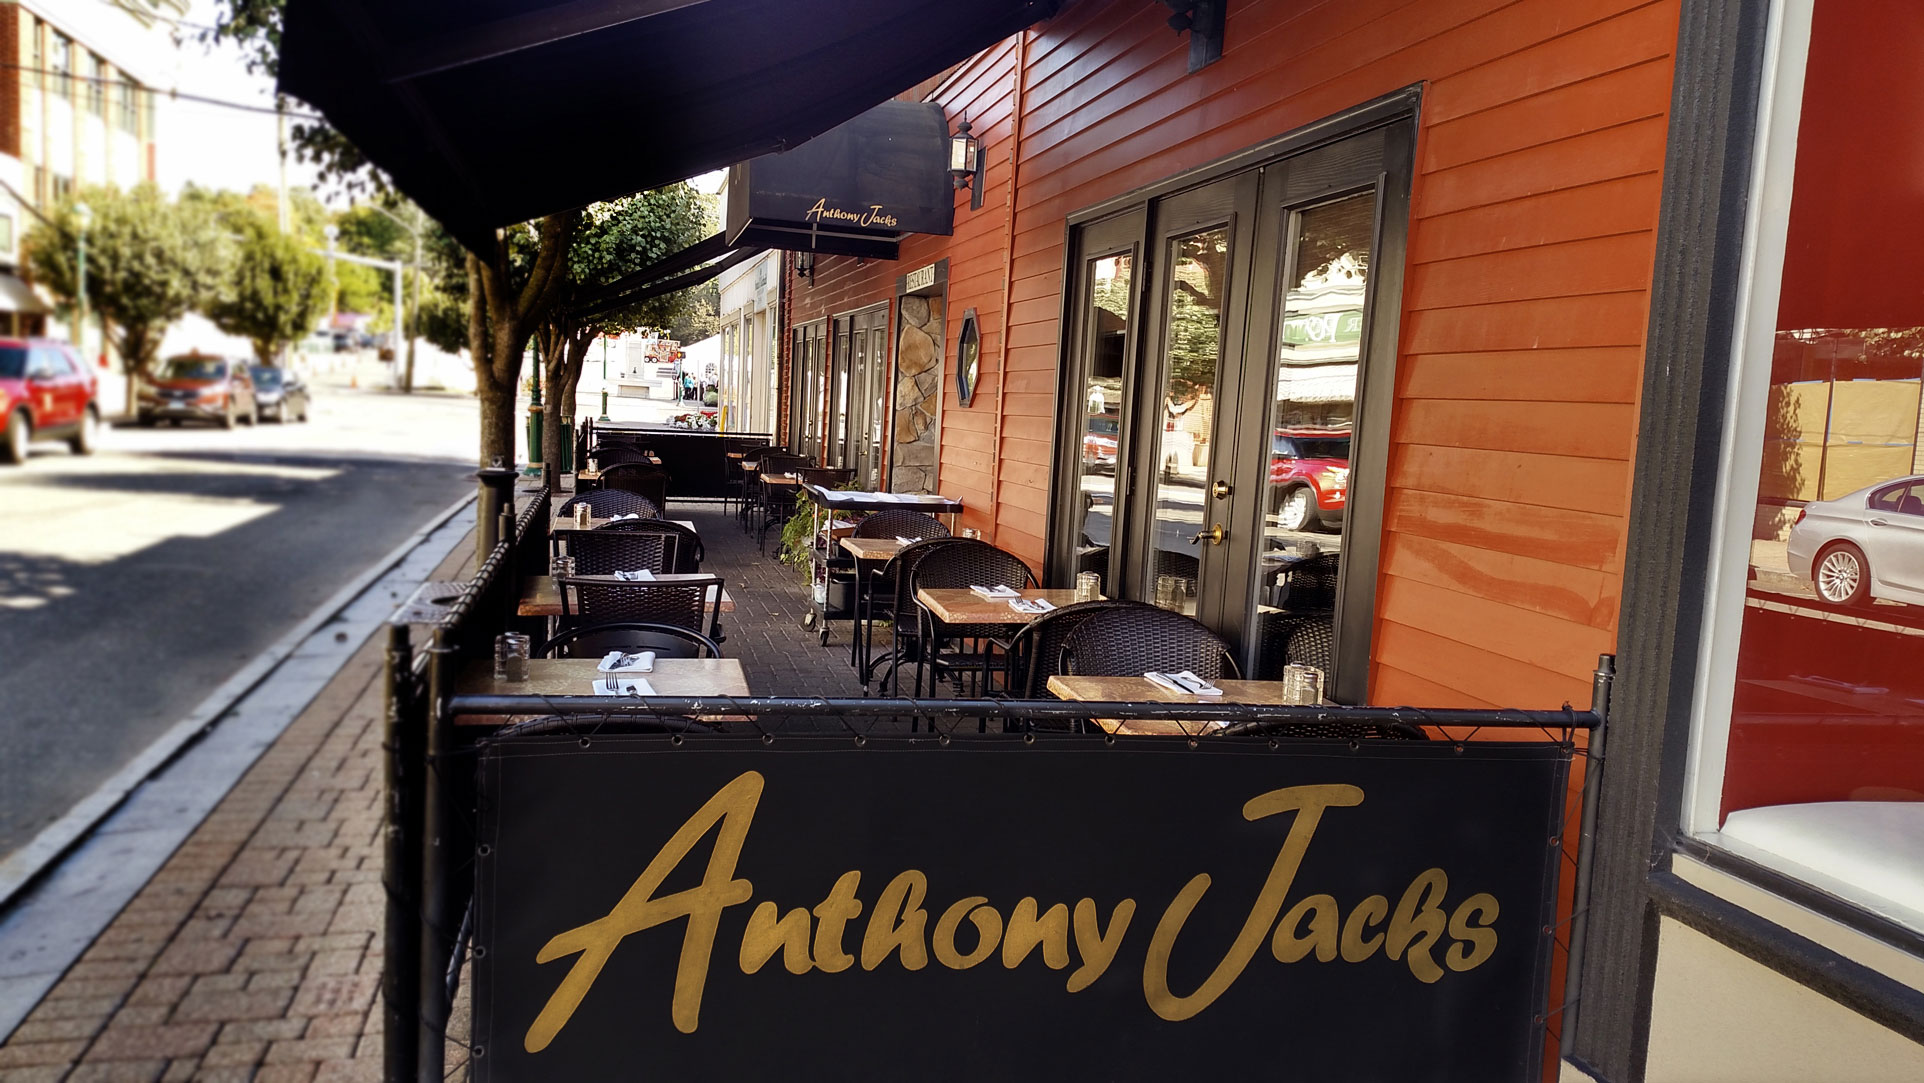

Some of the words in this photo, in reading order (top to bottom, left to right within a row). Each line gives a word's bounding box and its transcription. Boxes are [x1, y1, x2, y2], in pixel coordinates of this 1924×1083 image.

[805, 198, 860, 223] Anthony
[860, 205, 897, 227] Jacks
[525, 770, 1137, 1054] Anthony
[1143, 783, 1500, 1022] Jacks
